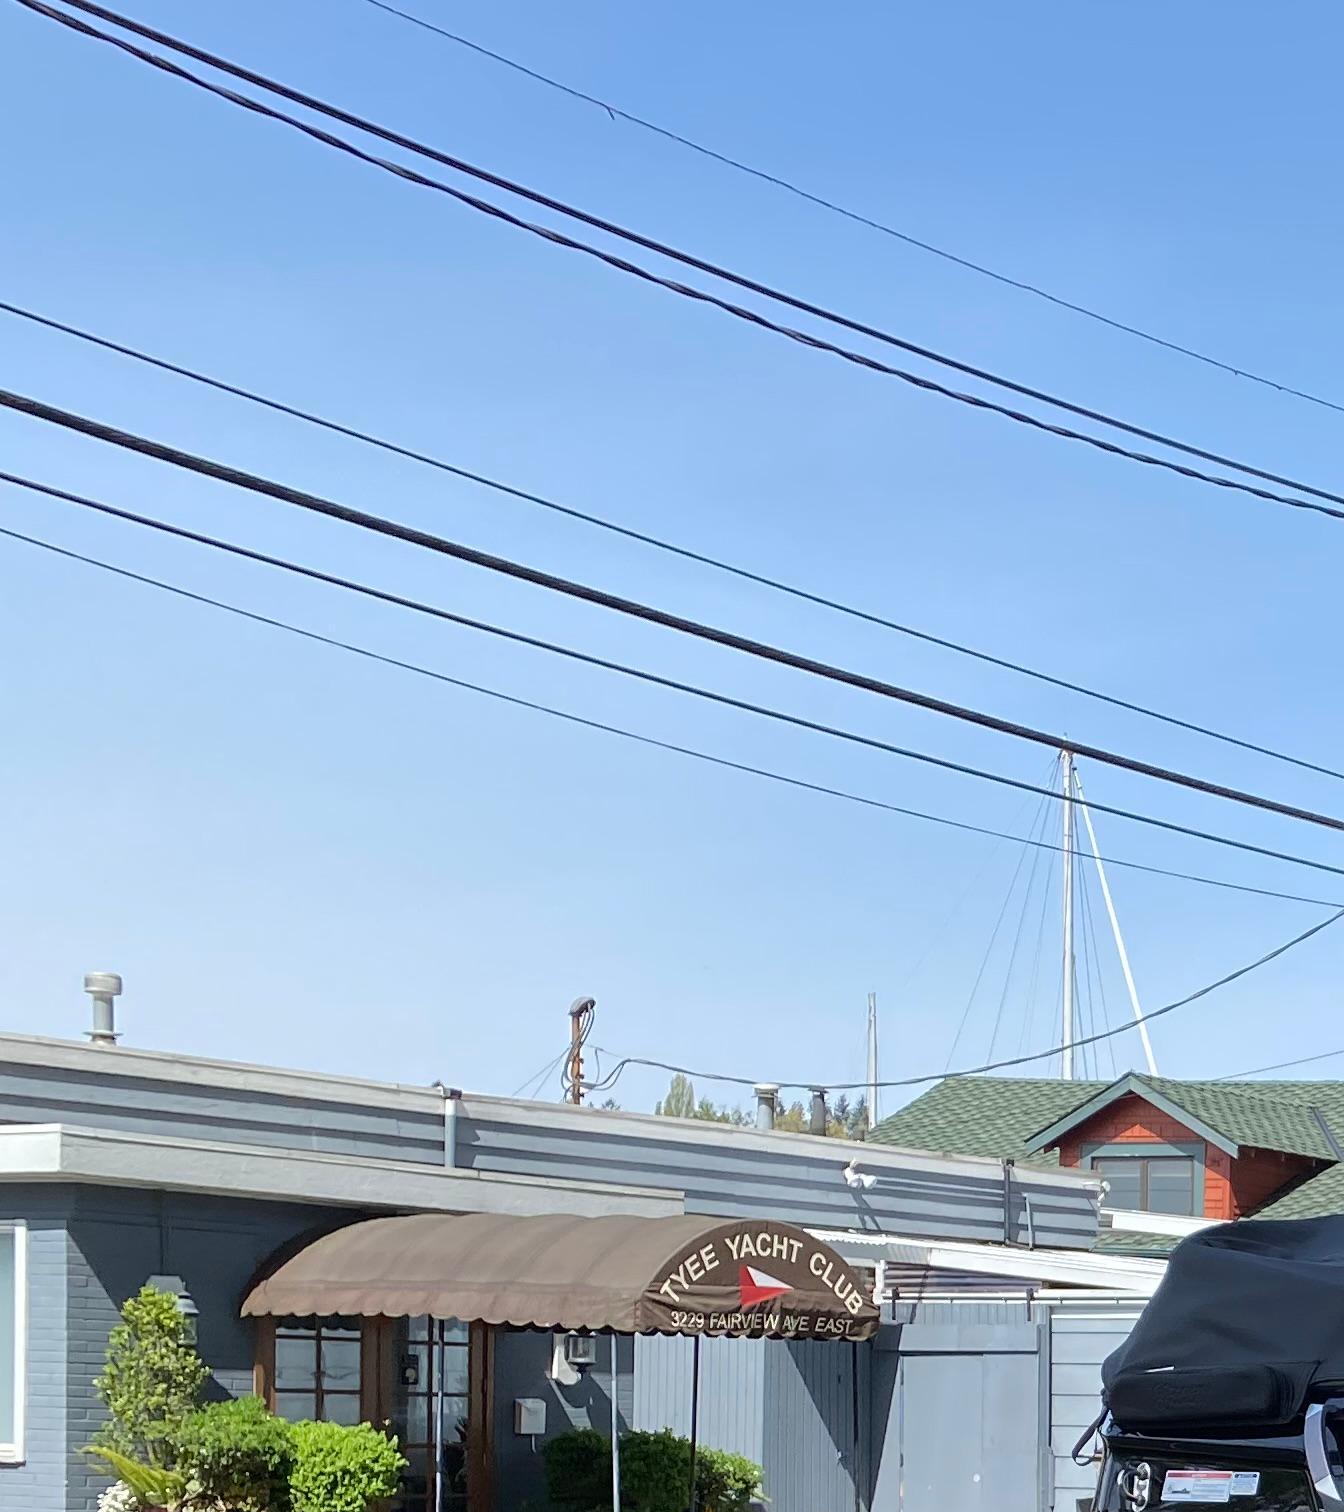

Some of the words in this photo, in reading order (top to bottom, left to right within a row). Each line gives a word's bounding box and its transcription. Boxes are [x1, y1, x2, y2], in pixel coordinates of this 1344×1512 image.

[660, 1243, 721, 1303] TYEE
[724, 1232, 803, 1263] YACHT
[809, 1252, 864, 1315] CLUB
[671, 1311, 705, 1328] 3229
[709, 1312, 780, 1330] FAIRVIEW
[783, 1315, 809, 1332] AVE
[815, 1317, 853, 1334] EAST
